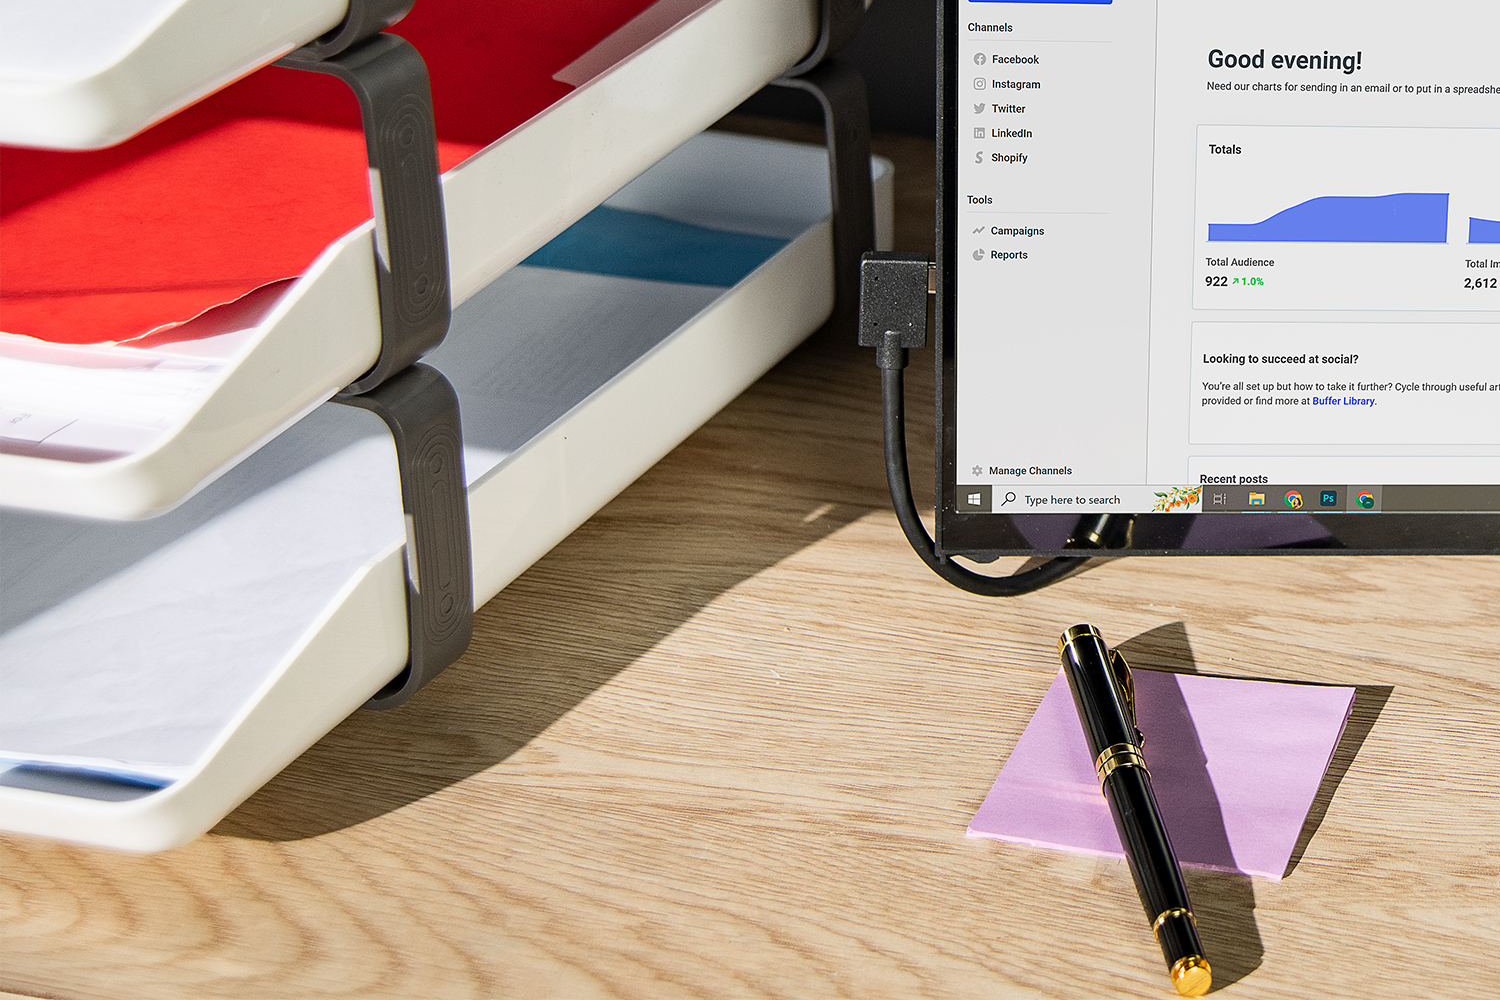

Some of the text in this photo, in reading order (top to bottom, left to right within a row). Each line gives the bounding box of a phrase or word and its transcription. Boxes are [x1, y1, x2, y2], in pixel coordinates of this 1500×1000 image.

[967, 22, 1013, 33] Channels
[992, 54, 1040, 65] Facebook
[1208, 48, 1362, 75] Good evening!
[992, 79, 1041, 91] Instagram
[991, 103, 1027, 114] Twitter
[991, 128, 1033, 138] LinkedIn
[1208, 144, 1242, 155] Totals
[991, 152, 1028, 165] Shopify
[966, 195, 993, 205] Tools
[990, 226, 1045, 238] Campaigns
[990, 250, 1028, 262] Reports
[1205, 257, 1275, 267] Total Audience
[1464, 258, 1488, 269] Total
[1205, 275, 1228, 287] 922
[1241, 276, 1265, 286] 1.0%
[1464, 277, 1498, 291] 2,612
[1203, 353, 1359, 366] Looking to succeed at social?
[989, 465, 1073, 477] Manage Channels
[1199, 474, 1269, 485] Recent posts
[1024, 494, 1121, 508] Type here to search
